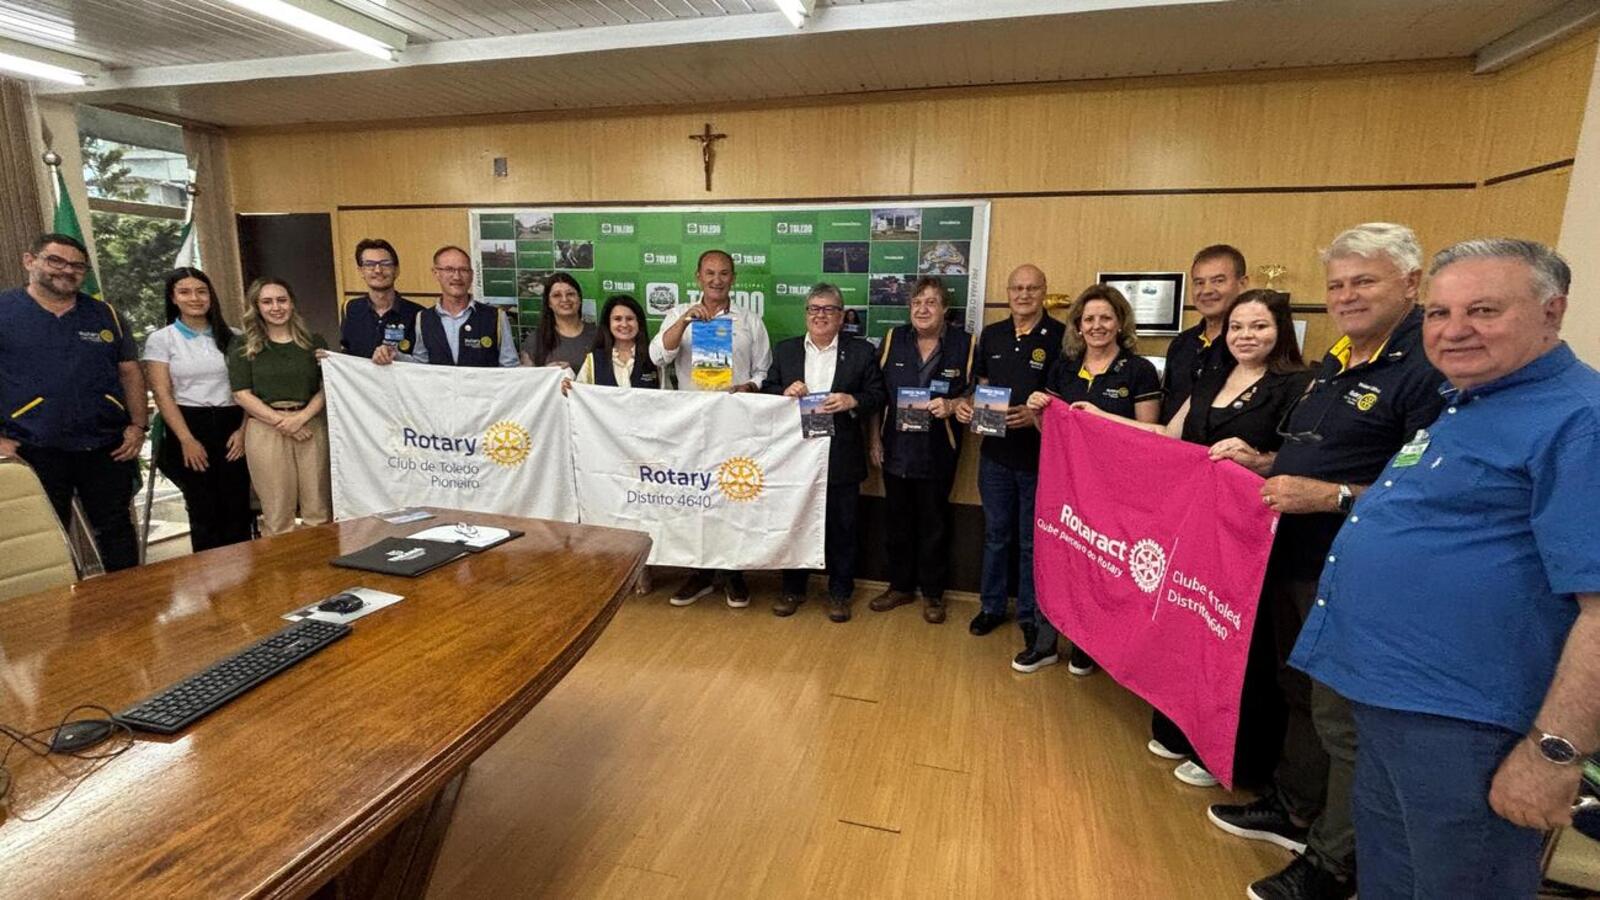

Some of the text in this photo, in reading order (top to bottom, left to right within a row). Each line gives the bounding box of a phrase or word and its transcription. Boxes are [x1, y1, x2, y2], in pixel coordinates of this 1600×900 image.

[404, 427, 477, 456] Rotary
[388, 456, 480, 475] Club de Toledo
[640, 465, 711, 491] Rotary
[627, 490, 711, 508] Distrito 4640
[1060, 504, 1127, 562] Rotaract
[1037, 518, 1059, 536] Clube
[1097, 555, 1123, 578] Rotary
[1173, 570, 1207, 596] Clube
